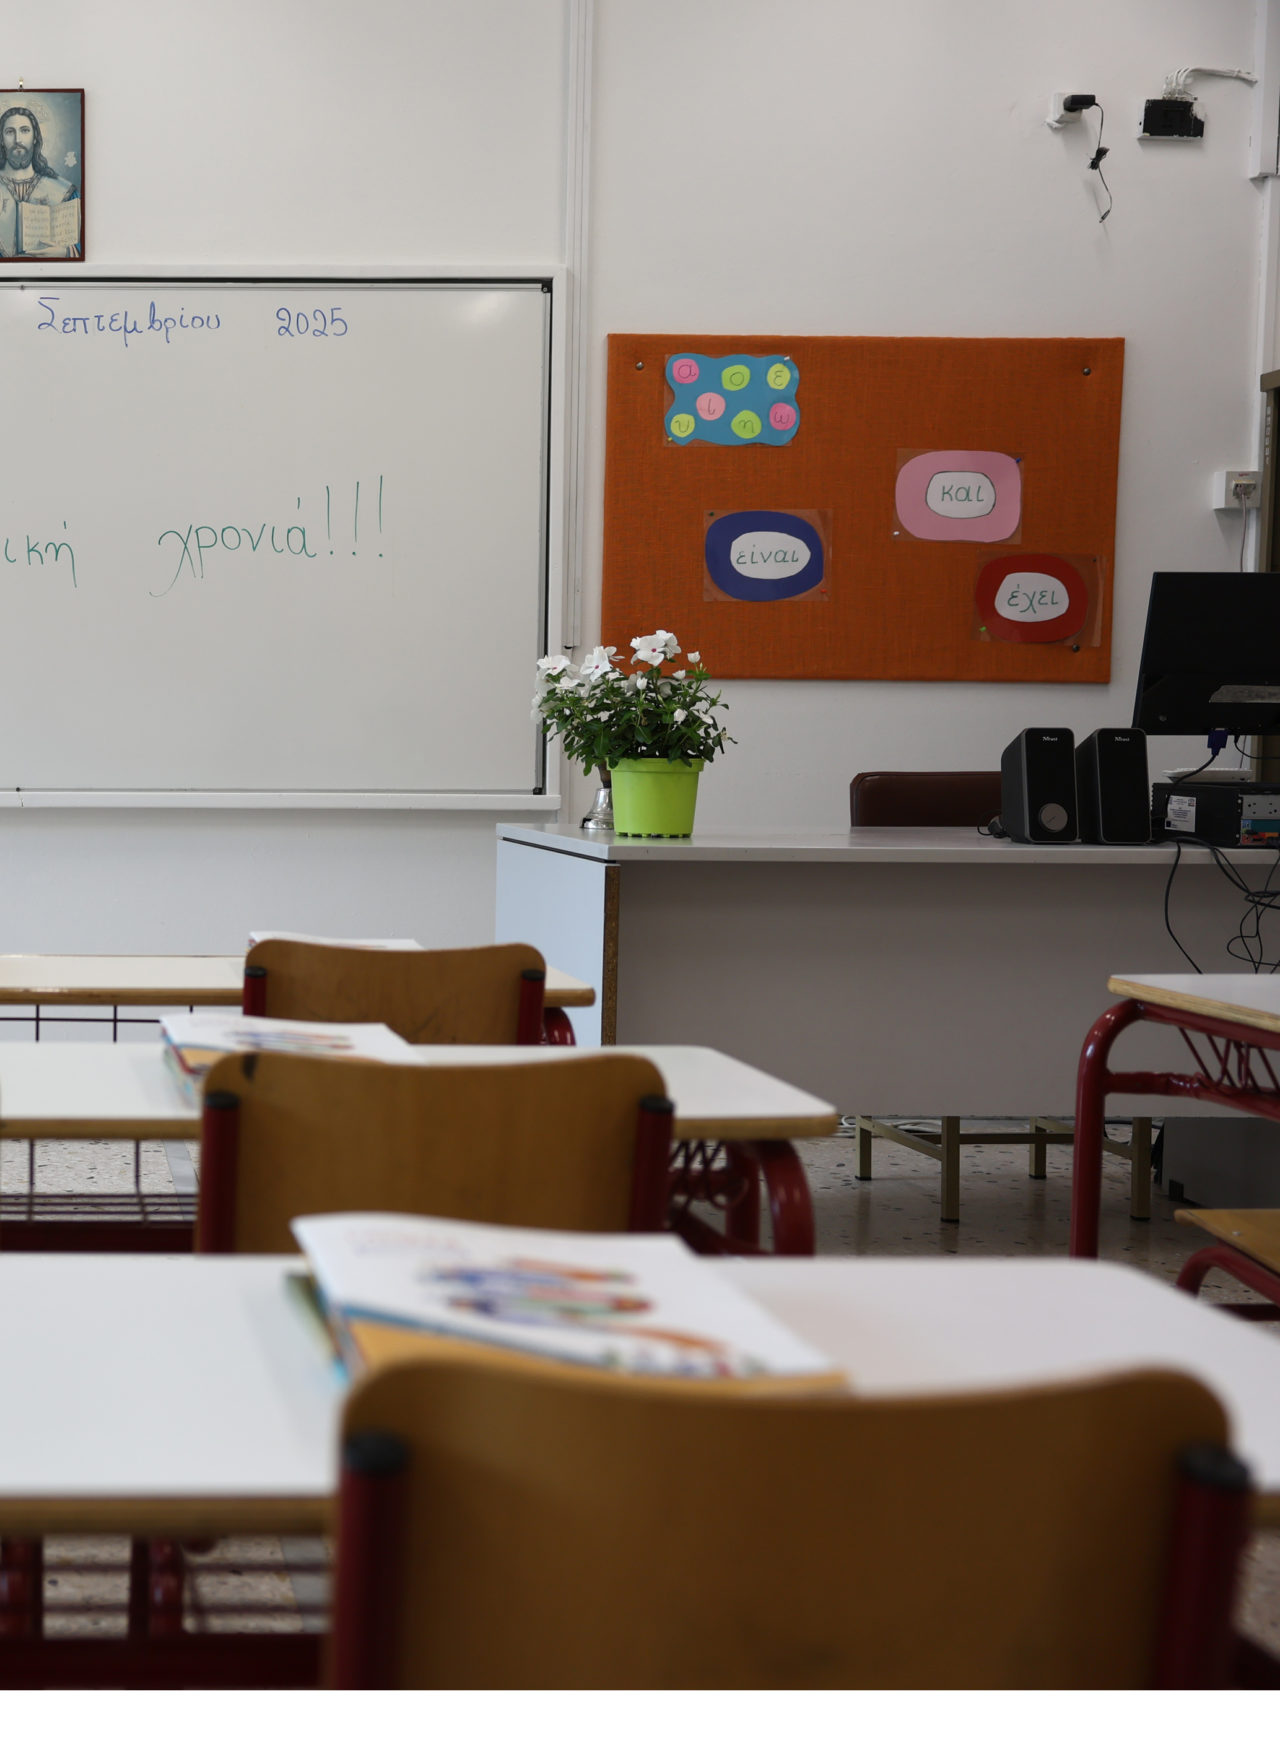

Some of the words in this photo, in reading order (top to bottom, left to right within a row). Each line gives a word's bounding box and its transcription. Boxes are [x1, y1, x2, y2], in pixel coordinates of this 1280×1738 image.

[38, 296, 221, 348] Σεπτεμβρίου
[276, 306, 348, 337] 2025
[940, 484, 985, 503] και
[149, 474, 383, 598] χρονιά!!!
[736, 544, 799, 565] είναι
[1007, 584, 1059, 614] έχει
